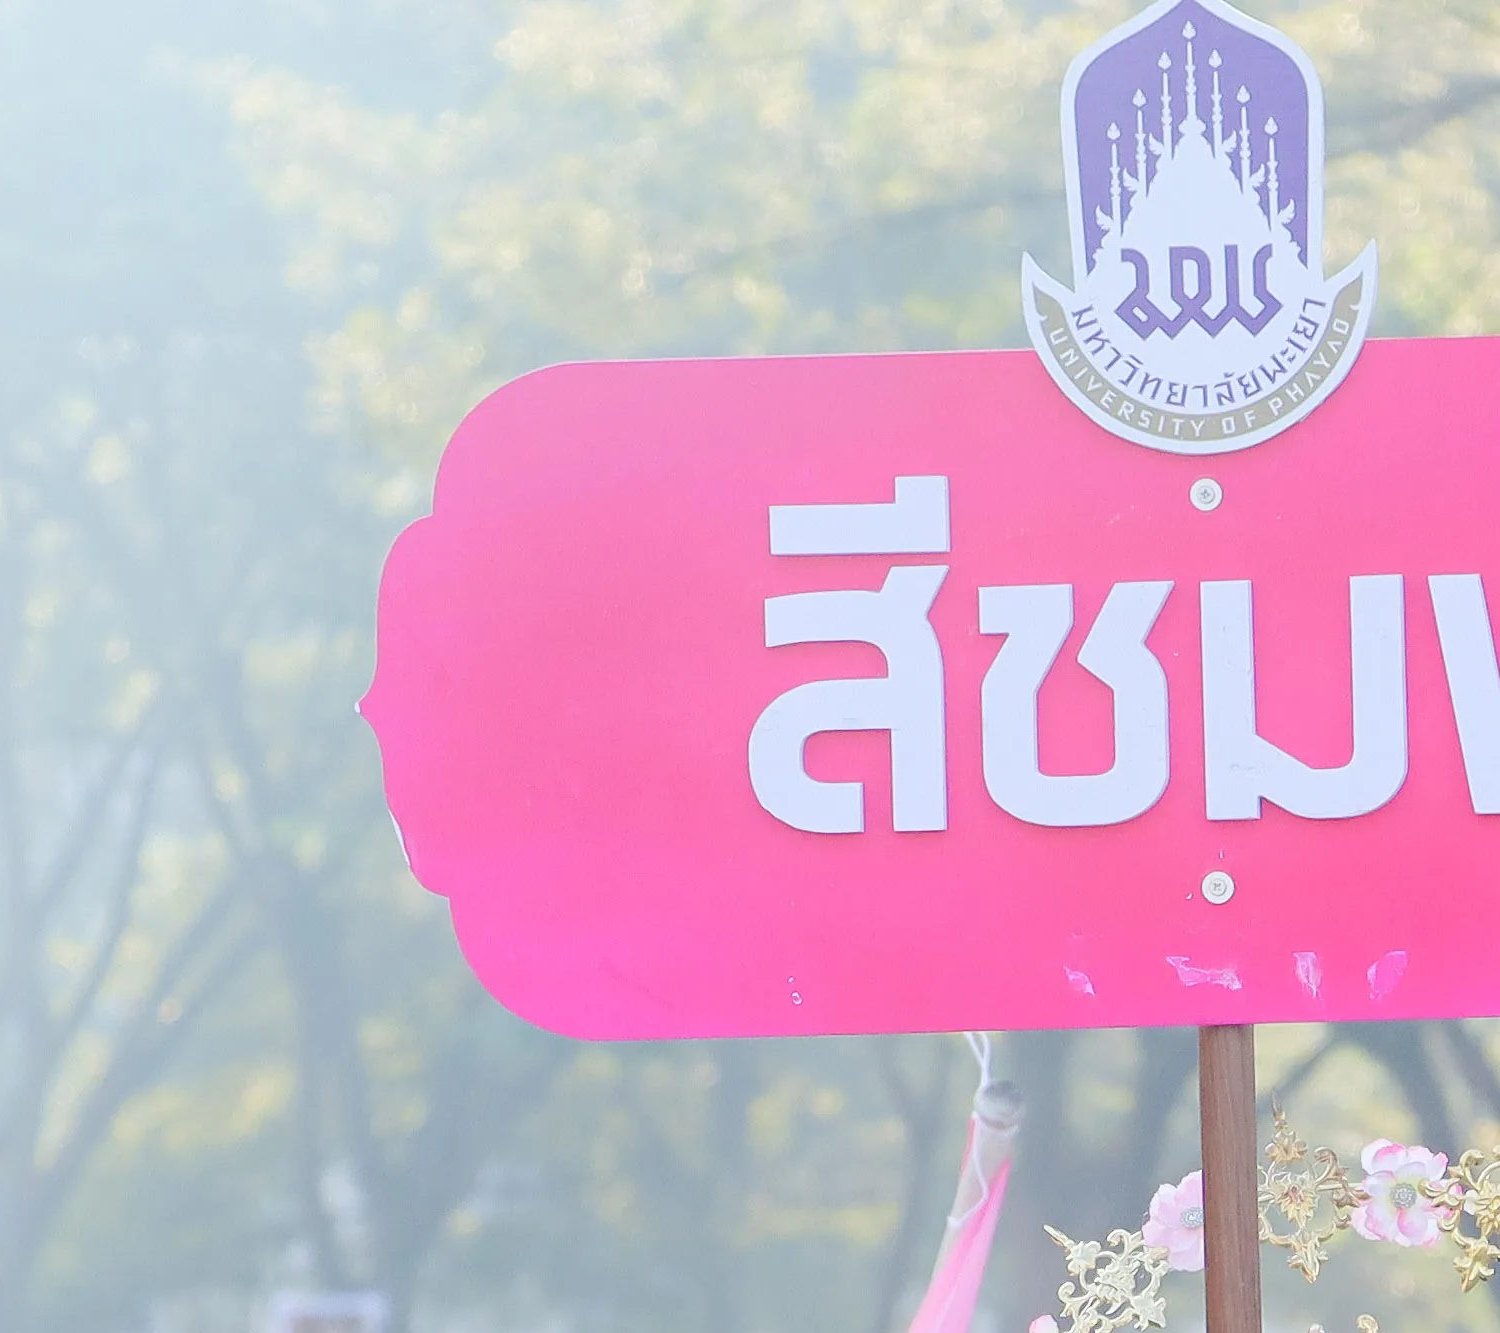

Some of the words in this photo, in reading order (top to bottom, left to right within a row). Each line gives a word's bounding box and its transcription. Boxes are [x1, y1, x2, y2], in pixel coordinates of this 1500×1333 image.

[1049, 327, 1206, 438] UNIVERSITY
[1221, 410, 1258, 435] OF
[1267, 318, 1350, 417] PHAYAO
[1071, 298, 1327, 408] มหาวิทยาลัยพะเยา
